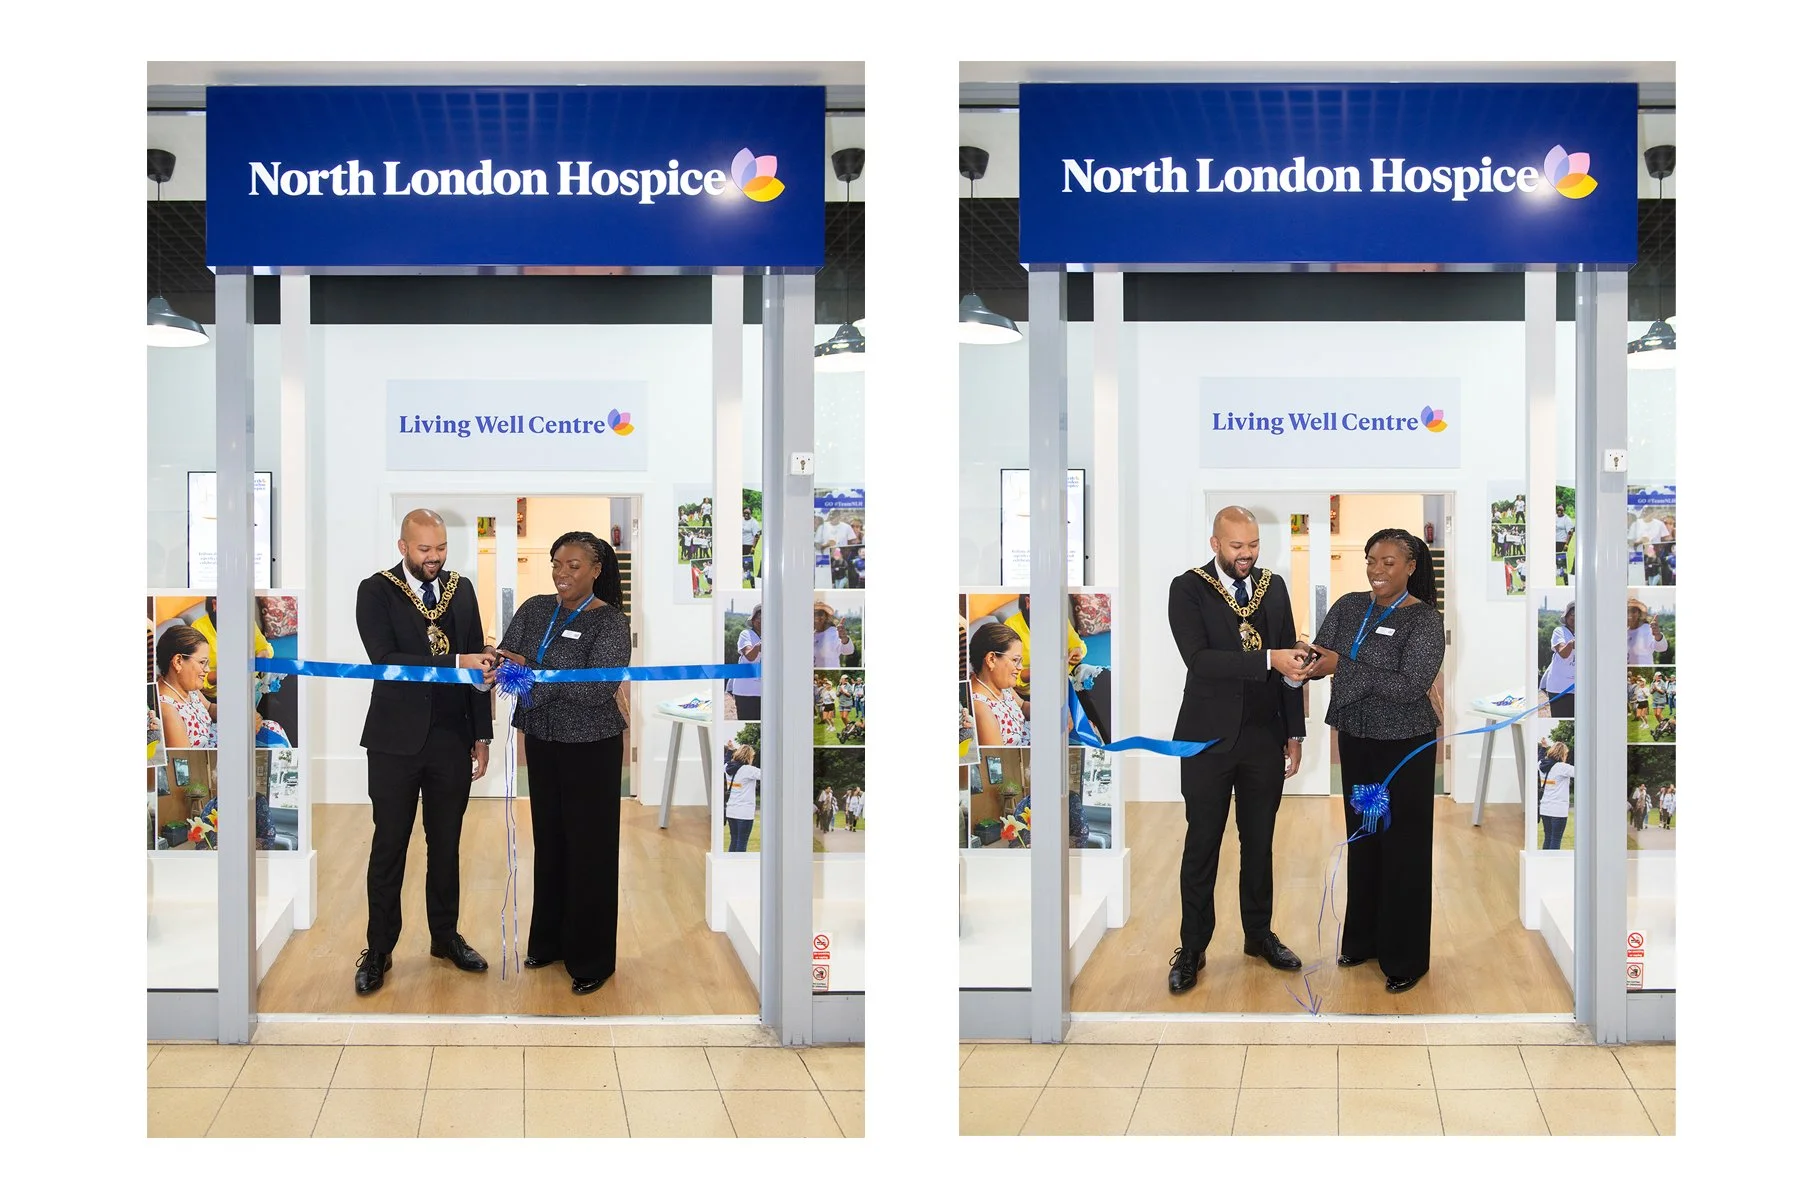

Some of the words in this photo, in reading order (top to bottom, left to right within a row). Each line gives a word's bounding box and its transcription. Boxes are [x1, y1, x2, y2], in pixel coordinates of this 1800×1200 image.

[249, 160, 375, 196] North
[383, 160, 549, 196] London
[557, 160, 726, 206] Hospice
[1062, 157, 1188, 193] North
[1196, 157, 1362, 193] London
[1370, 157, 1539, 203] Hospice
[399, 415, 471, 438] Living
[475, 415, 525, 434] Well
[528, 415, 606, 434] Centre
[1212, 412, 1284, 435] Living
[1288, 412, 1338, 431] Well
[1341, 412, 1419, 431] Centre
